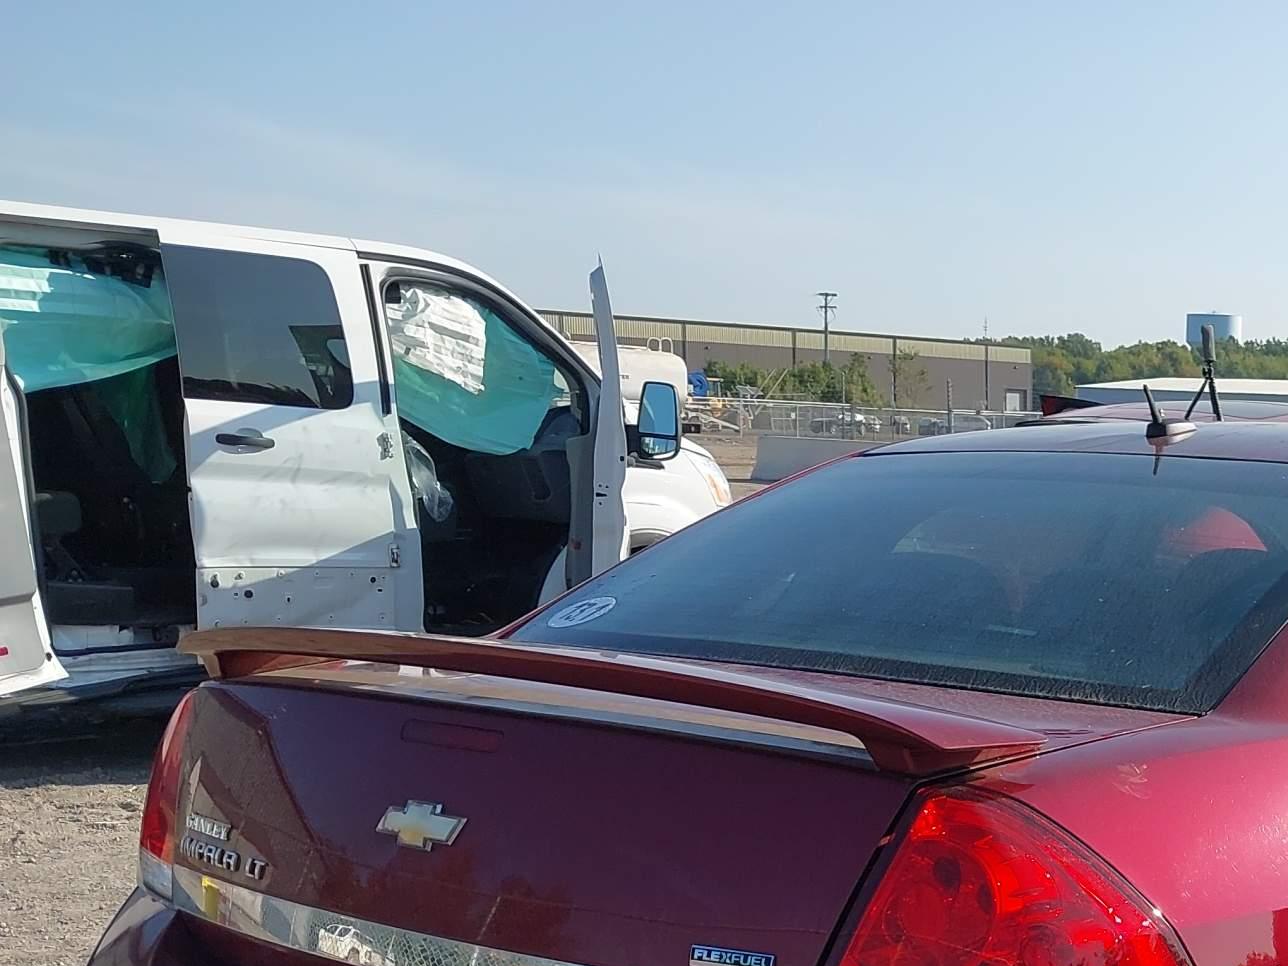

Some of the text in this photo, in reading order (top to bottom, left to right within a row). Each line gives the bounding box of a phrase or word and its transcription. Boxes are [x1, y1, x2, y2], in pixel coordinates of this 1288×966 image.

[186, 813, 232, 841] GANLEY
[180, 836, 268, 880] IMPALA LT
